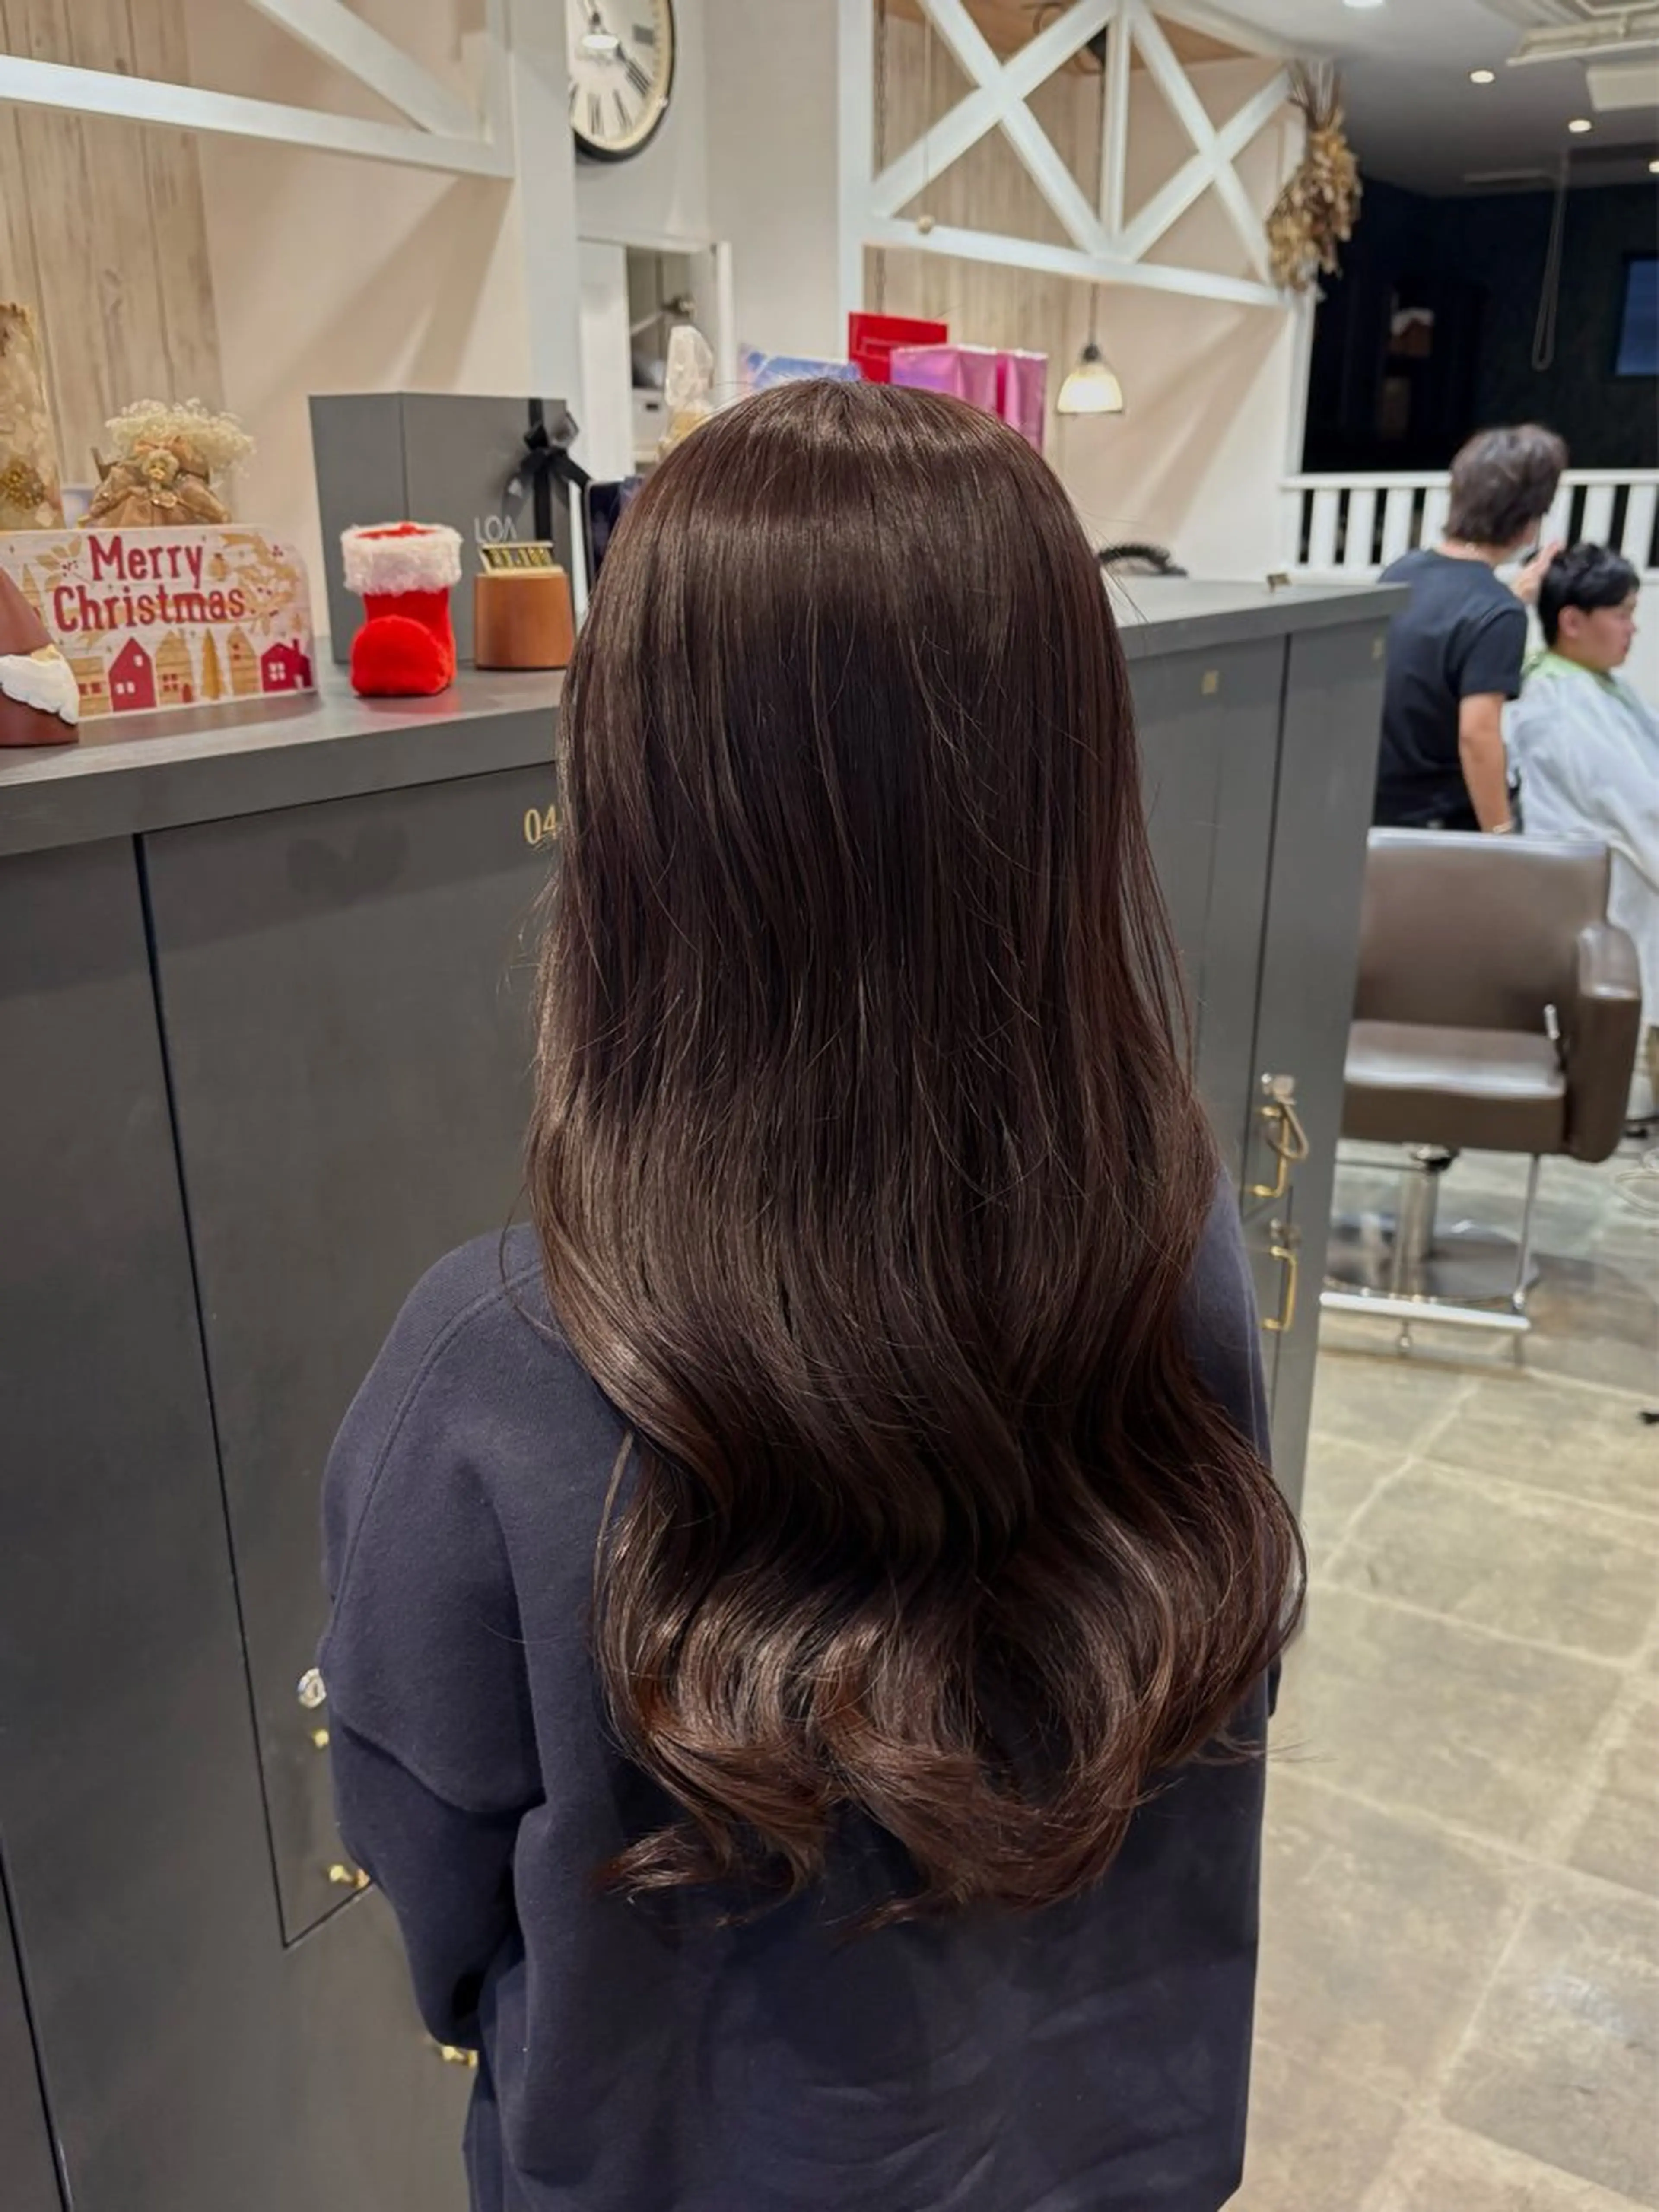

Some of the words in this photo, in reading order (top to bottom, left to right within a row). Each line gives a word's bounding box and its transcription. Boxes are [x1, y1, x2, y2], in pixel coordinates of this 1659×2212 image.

[88, 535, 203, 589] Merry
[53, 584, 245, 632] Christmas
[524, 804, 556, 845] 04
